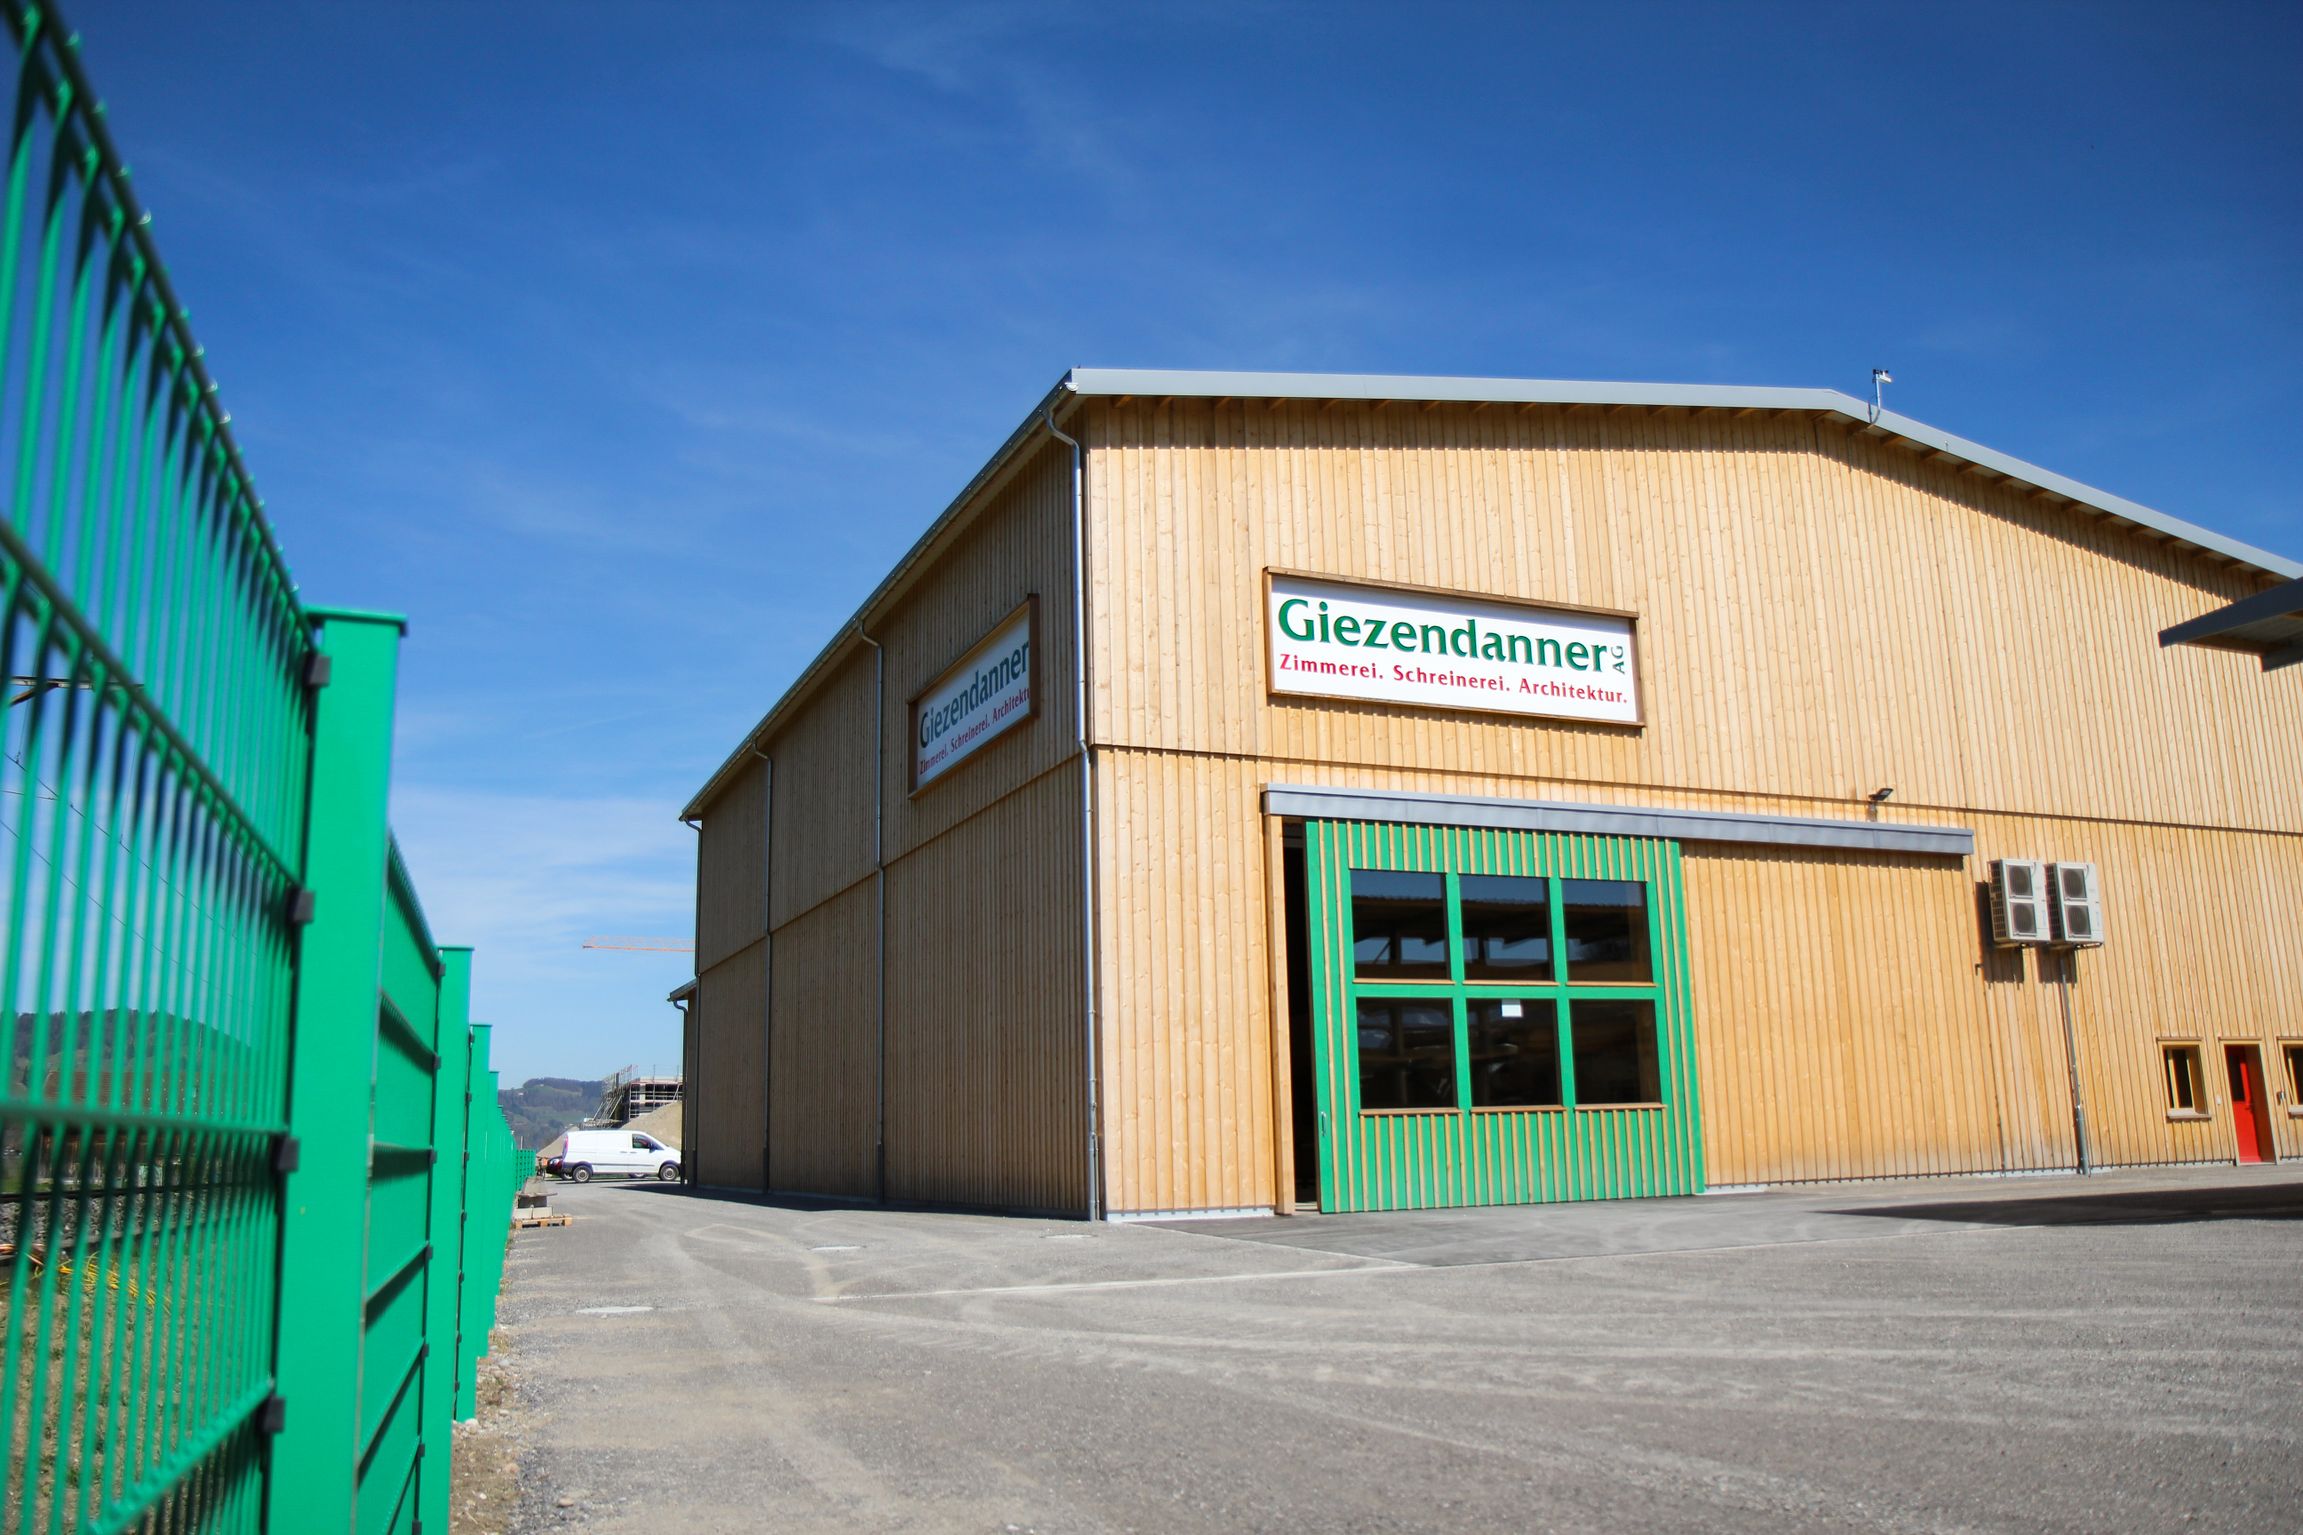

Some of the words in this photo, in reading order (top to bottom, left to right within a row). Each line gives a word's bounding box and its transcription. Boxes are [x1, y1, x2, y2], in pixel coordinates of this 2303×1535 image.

[1278, 598, 1607, 672] Giezendanner
[1611, 645, 1625, 674] AG
[920, 641, 1029, 748] Giezendanner
[1279, 653, 1383, 679] Zimmerei.
[1393, 665, 1510, 691] Schreinerei.
[1519, 678, 1628, 703] Architektur.
